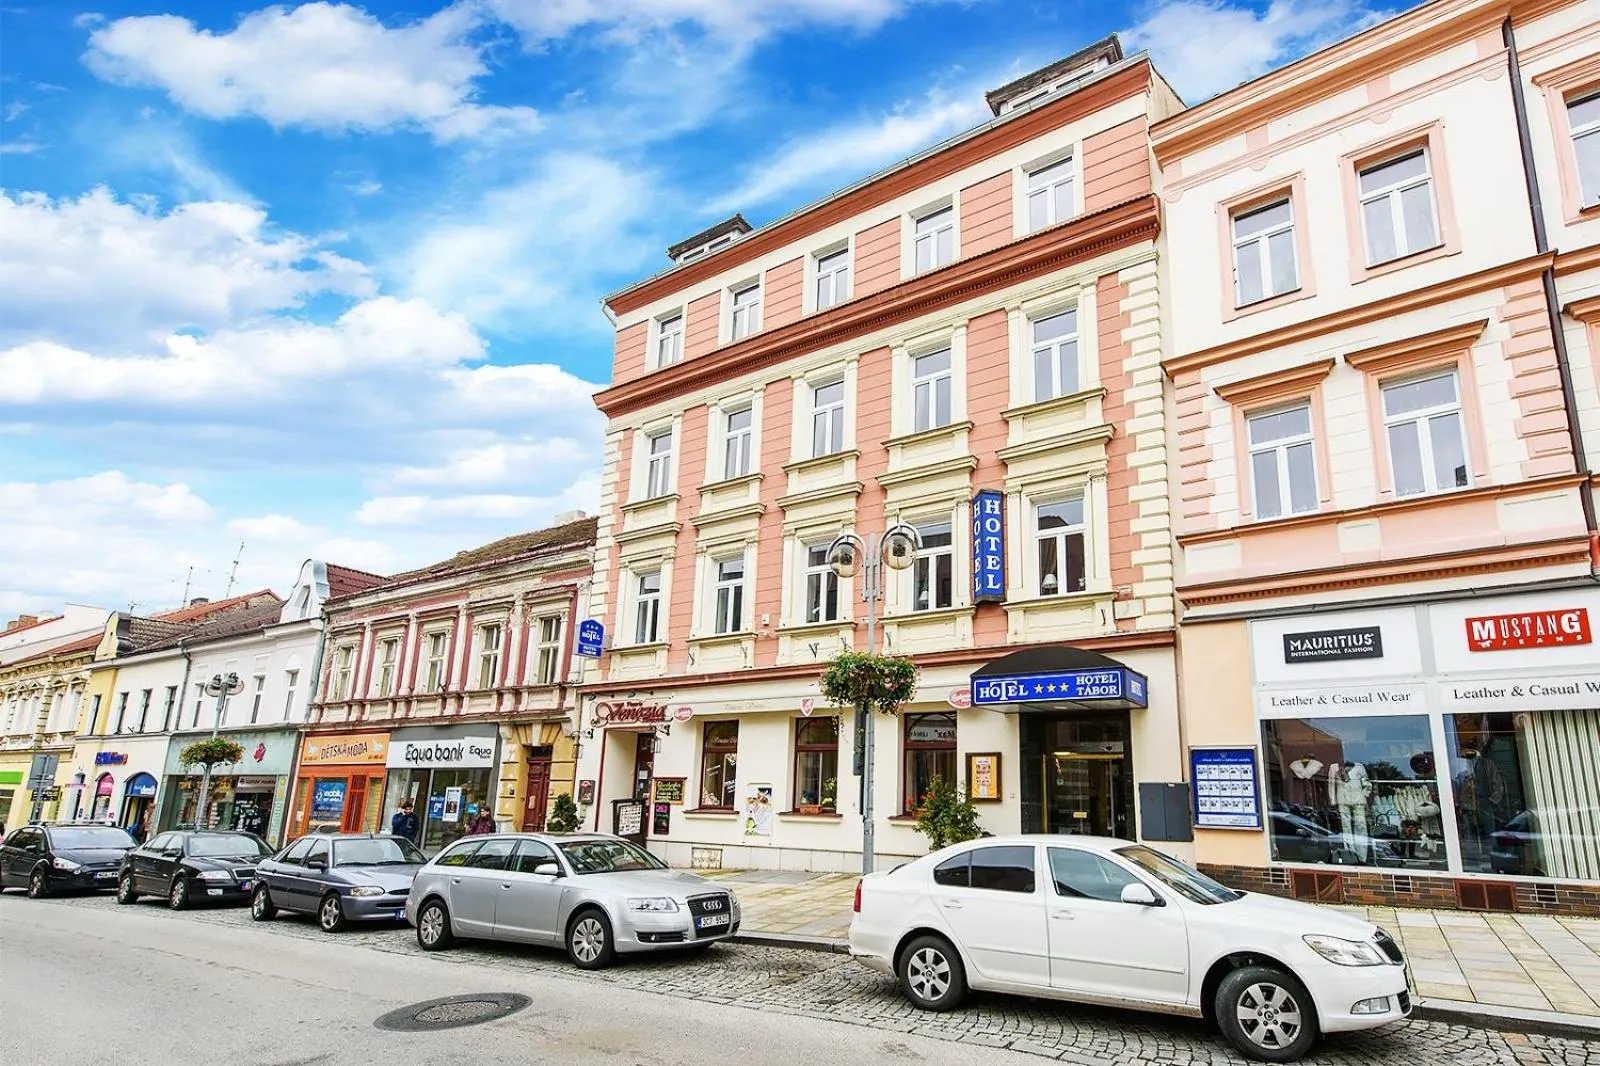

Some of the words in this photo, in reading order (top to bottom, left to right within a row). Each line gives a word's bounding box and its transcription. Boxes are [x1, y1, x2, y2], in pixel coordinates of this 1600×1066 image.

[973, 501, 982, 593] HOTEL
[984, 499, 1001, 590] HOTEL
[1471, 612, 1582, 641] MUSTANG
[1289, 633, 1373, 652] MAURITIUS
[1290, 648, 1342, 658] INTERNATIONAL
[1343, 645, 1374, 655] FASHION
[979, 680, 1029, 701] HOTEL
[1075, 674, 1118, 686] HOTEL
[1076, 684, 1118, 696] TÁBOR
[1453, 687, 1507, 700] Leather
[1510, 685, 1525, 697] &
[1529, 682, 1581, 696] Casual
[1271, 696, 1314, 707] Leather
[1317, 695, 1328, 705] &
[1332, 692, 1373, 704] Casual
[1376, 692, 1412, 702] Wear
[405, 743, 433, 765] Equa
[434, 743, 465, 761] bank
